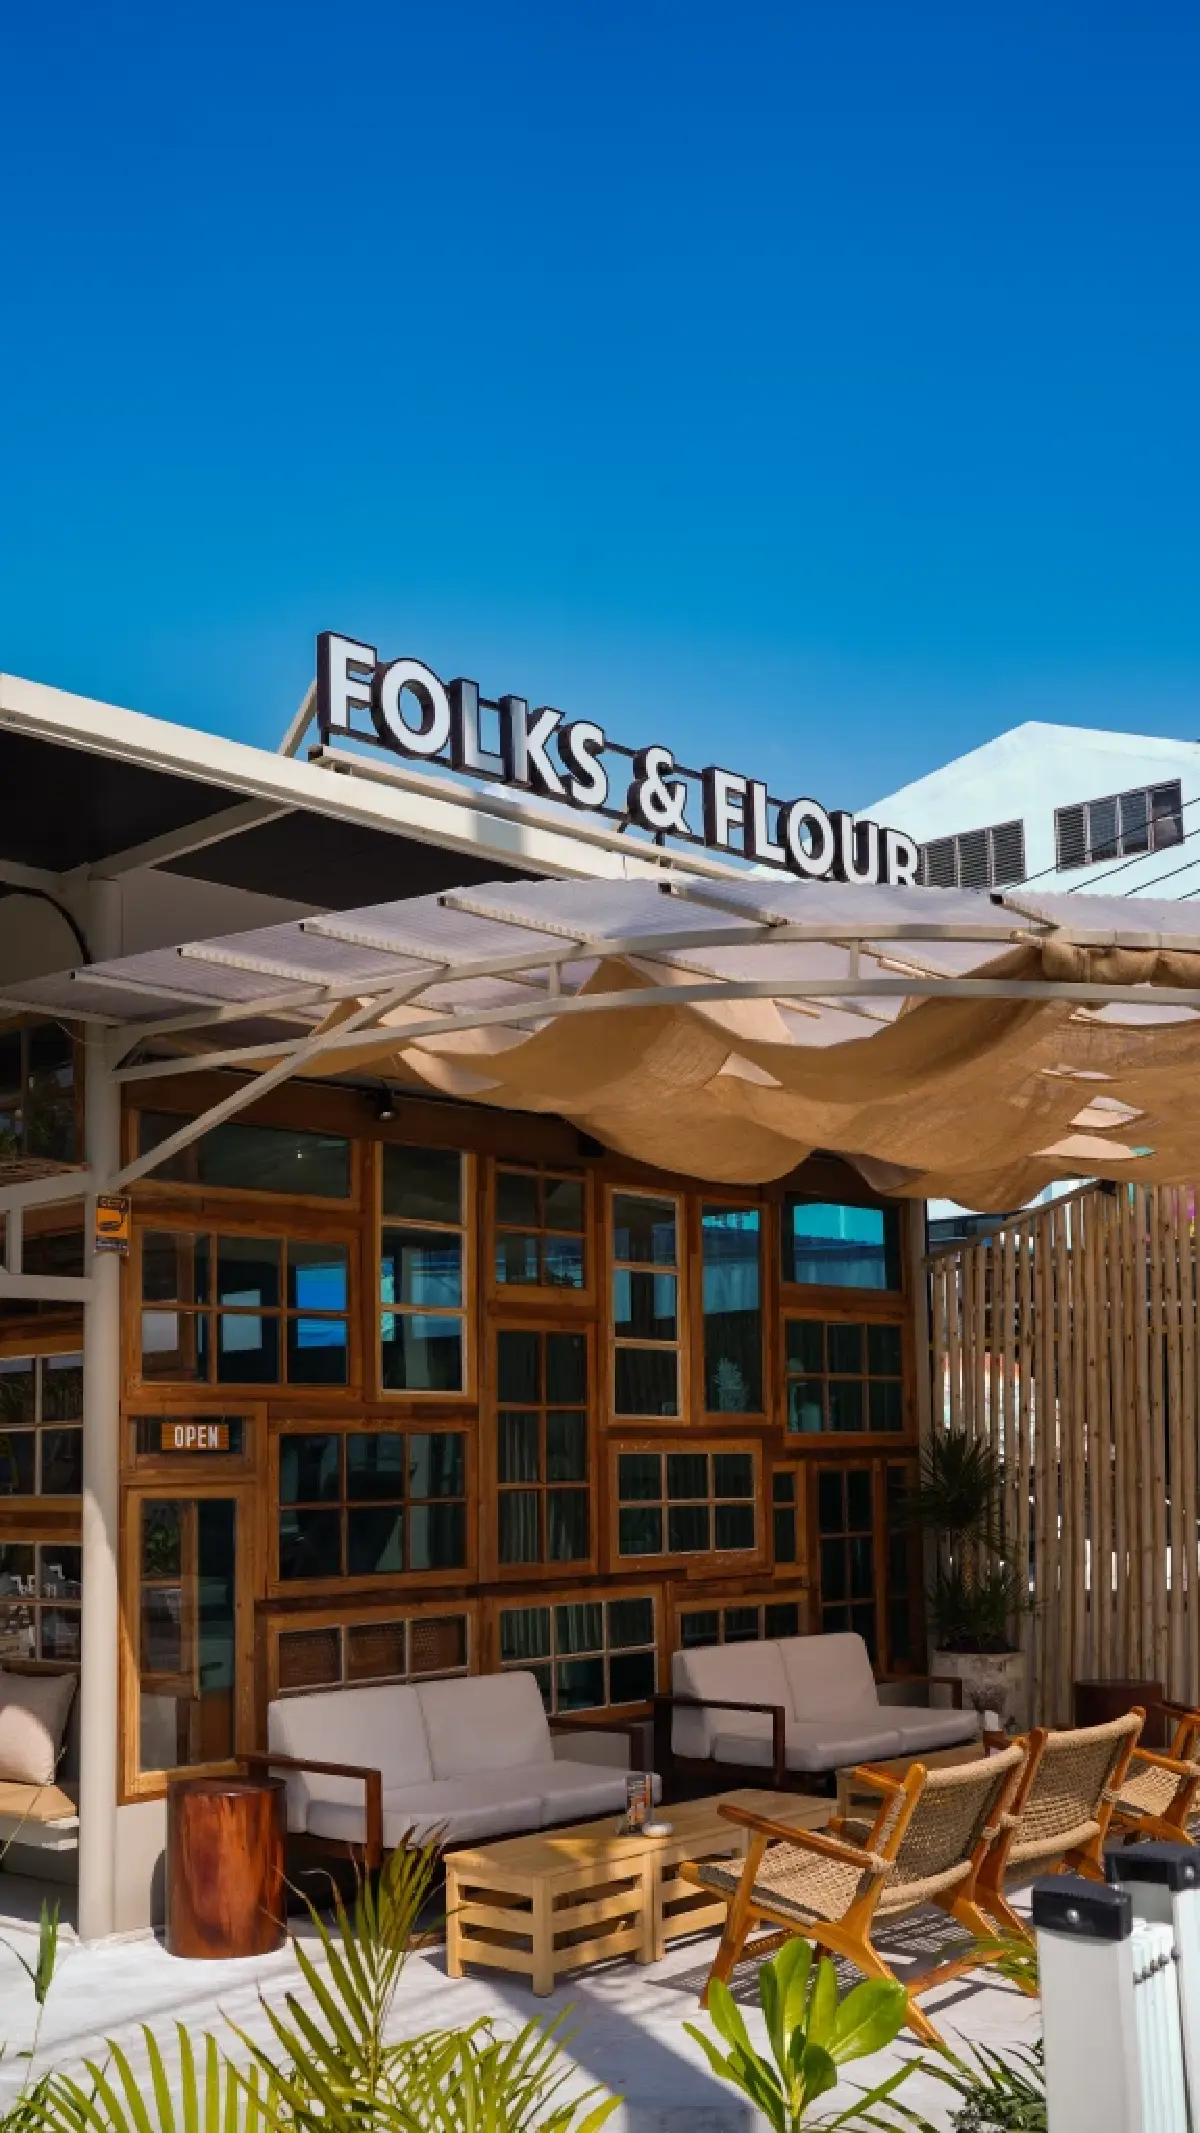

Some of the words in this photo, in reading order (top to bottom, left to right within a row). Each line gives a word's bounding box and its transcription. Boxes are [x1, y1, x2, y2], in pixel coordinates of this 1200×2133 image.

[318, 632, 608, 807] FOLKS
[629, 745, 692, 834] &
[703, 767, 920, 885] FLOUR
[174, 1425, 219, 1448] OPEN
